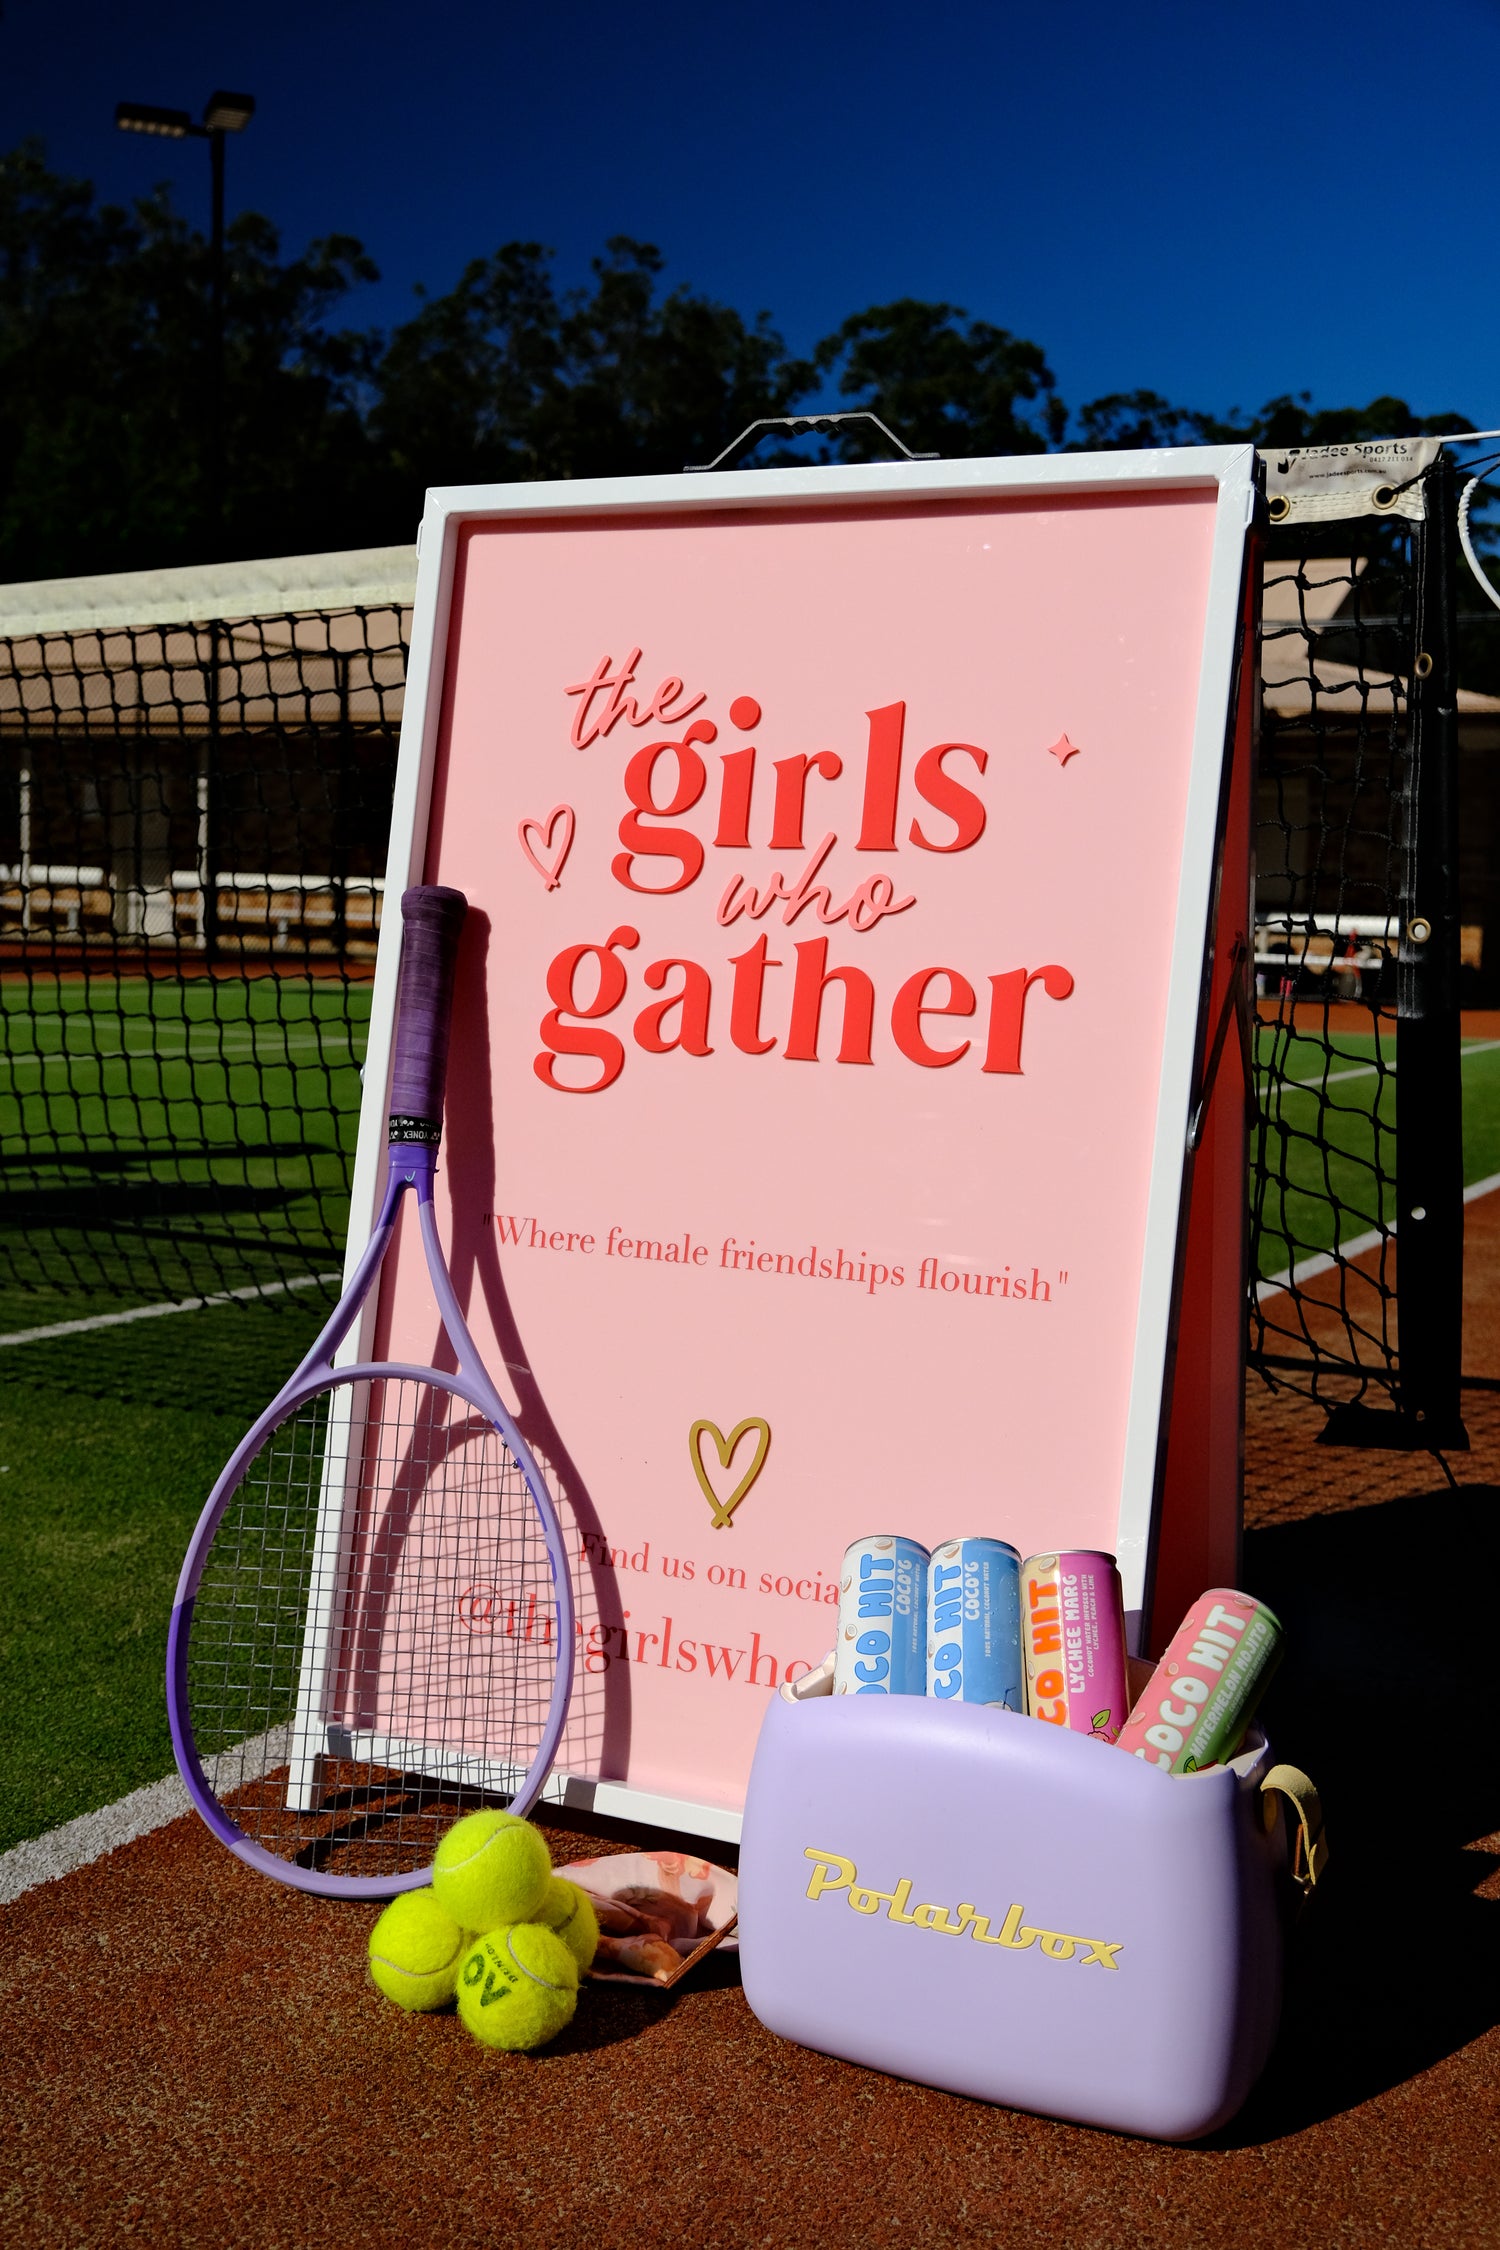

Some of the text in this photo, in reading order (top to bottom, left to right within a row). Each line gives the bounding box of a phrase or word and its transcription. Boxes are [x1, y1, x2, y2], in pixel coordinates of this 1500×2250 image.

[1354, 442, 1408, 459] Sports
[564, 646, 708, 749] the
[611, 696, 989, 894] girls
[716, 832, 917, 931] who
[533, 925, 1074, 1094] gather
[605, 1226, 709, 1267] female
[719, 1238, 906, 1296] friendships
[578, 1531, 650, 1574] Find
[661, 1556, 696, 1581] us
[707, 1563, 748, 1590] on
[858, 1554, 894, 1618] HIT
[934, 1564, 962, 1634] HIT
[1028, 1578, 1062, 1656] HIT
[1062, 1574, 1086, 1694] LYCHEE MARG
[1082, 1592, 1090, 1620] INFUSED
[1089, 1598, 1097, 1620] PEACH
[1086, 1646, 1095, 1678] COCONUT
[1186, 1604, 1246, 1672] HIT
[1190, 1670, 1242, 1758] WATERMELON
[1235, 1622, 1268, 1672] MOJITO
[803, 1846, 1124, 1970] Polarbox
